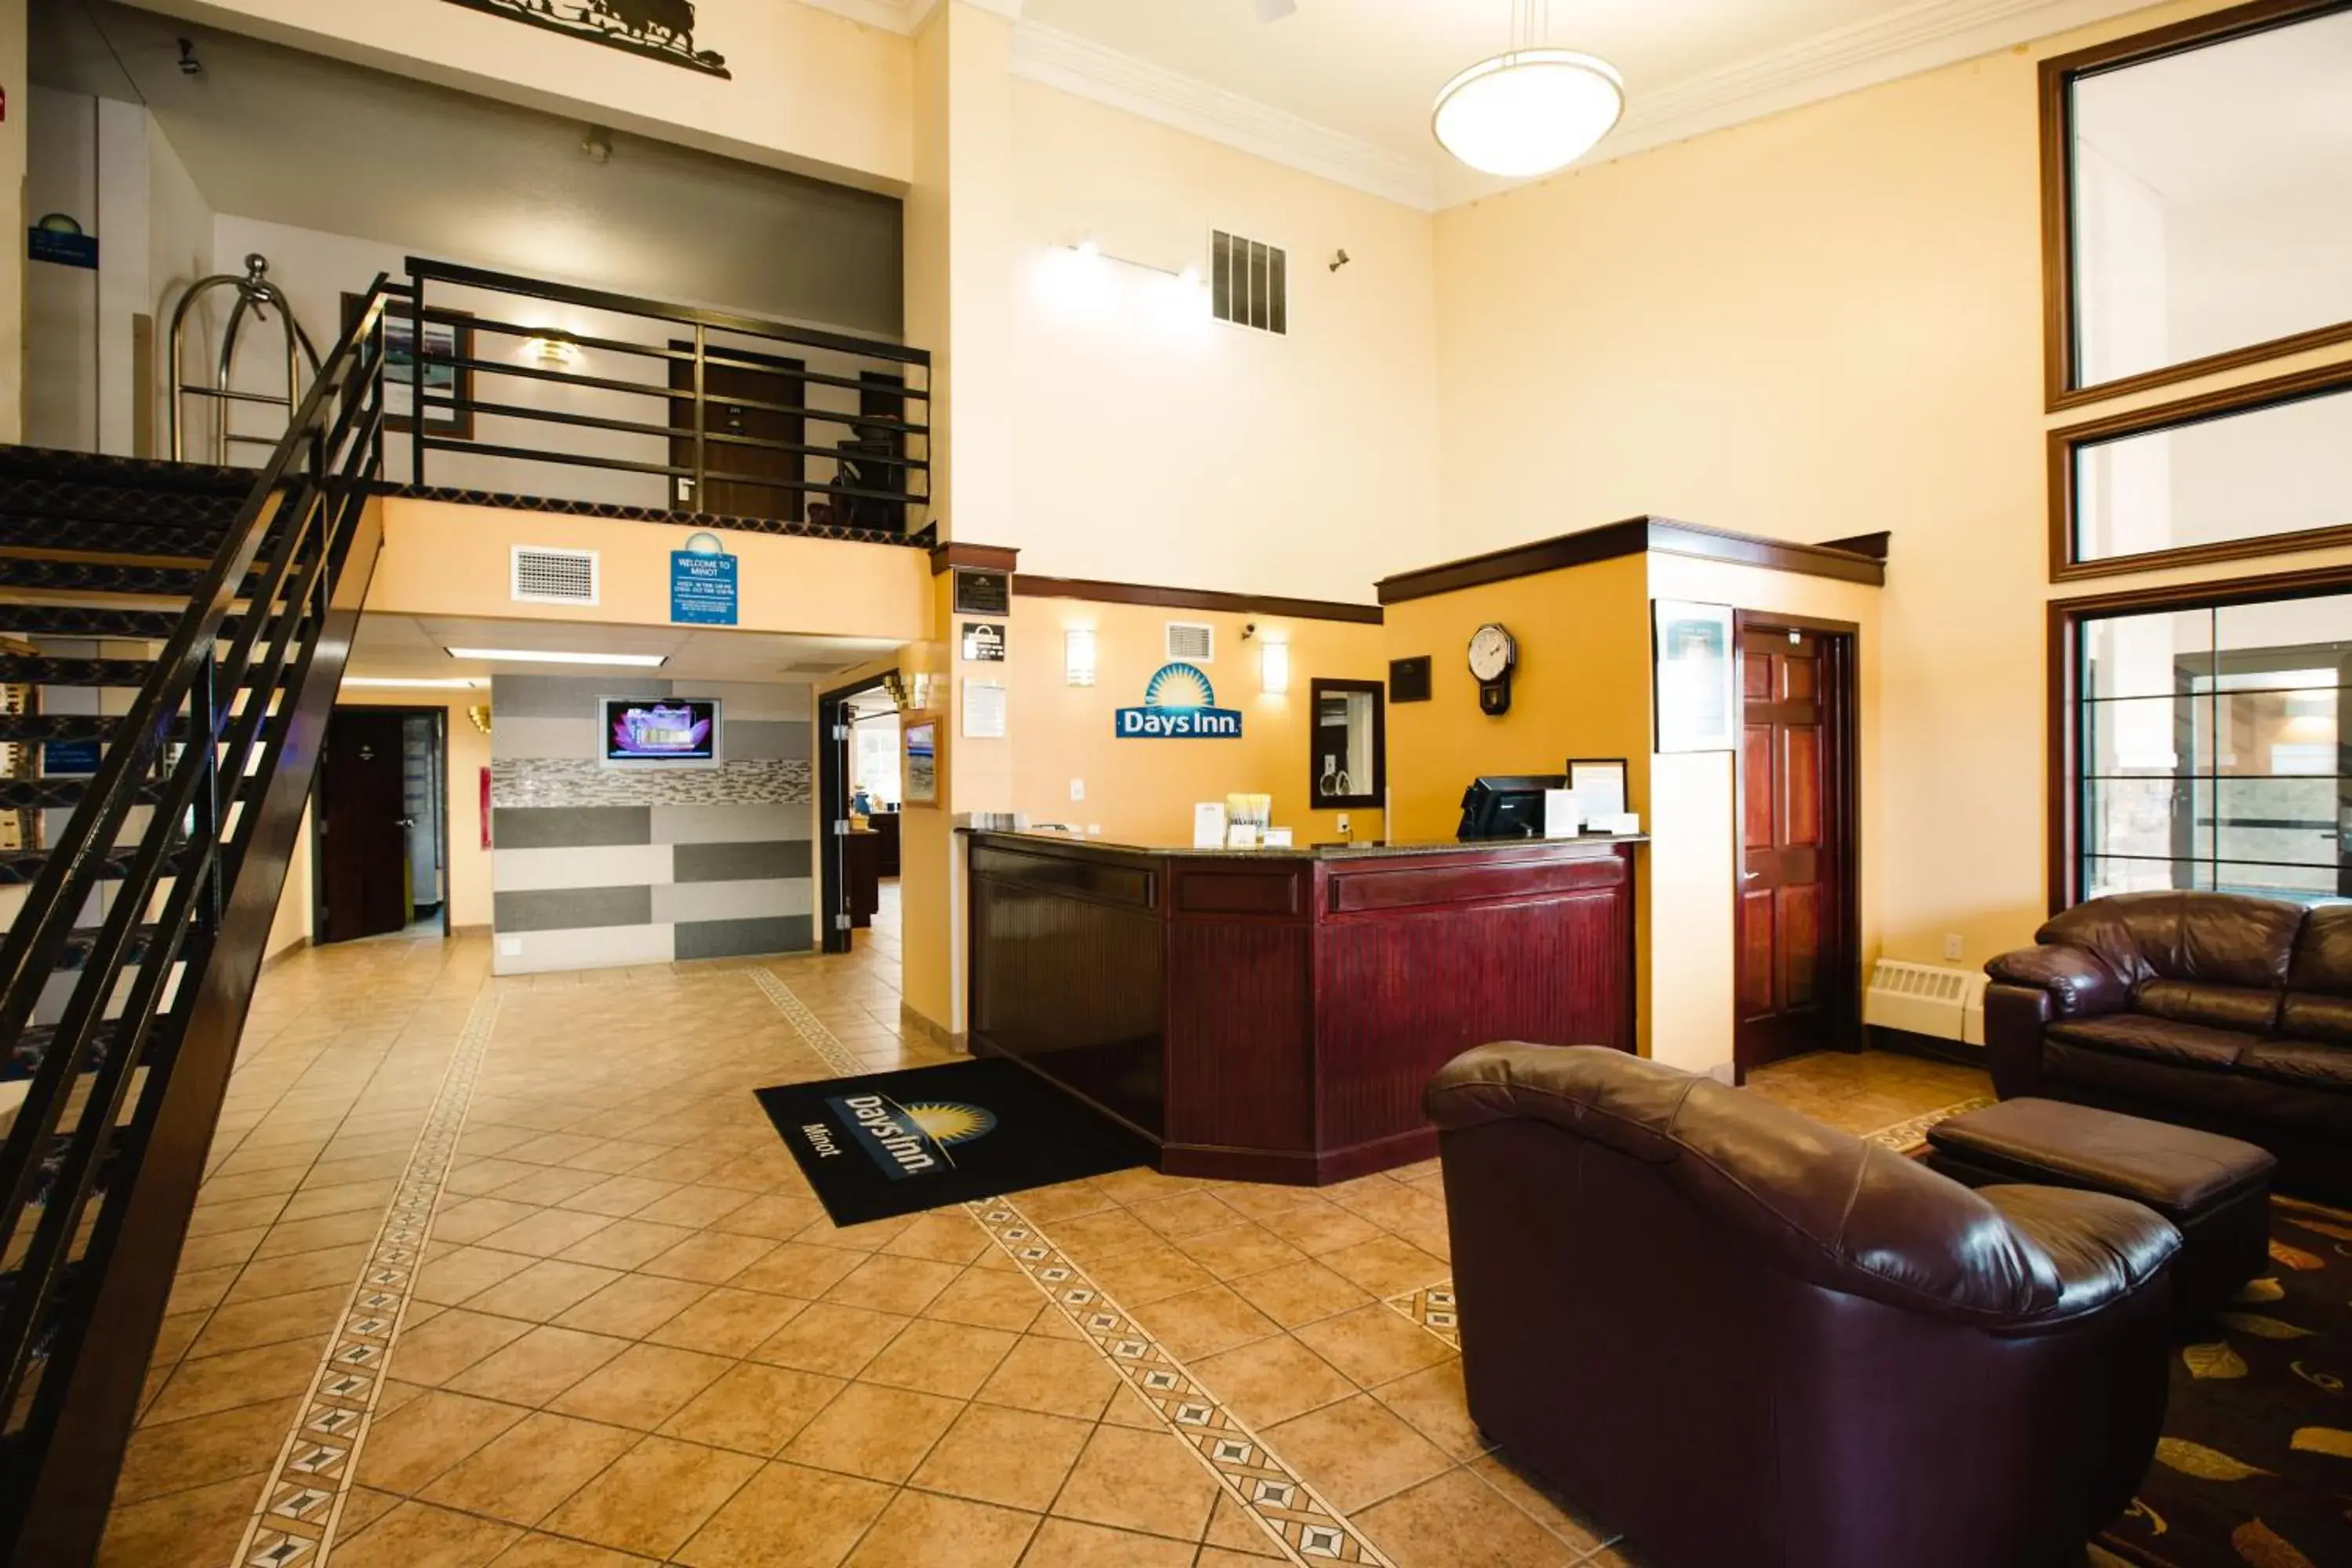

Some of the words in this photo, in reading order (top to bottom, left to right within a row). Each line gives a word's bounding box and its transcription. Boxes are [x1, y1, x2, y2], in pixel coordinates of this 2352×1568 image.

[678, 558, 718, 568] WELCOME
[719, 561, 731, 569] TO
[691, 567, 717, 576] MINOT
[1124, 711, 1190, 735] Days
[1194, 712, 1236, 733] Inn
[802, 1123, 841, 1158] Minot
[845, 1096, 902, 1141] Days
[882, 1136, 935, 1172] Inn
